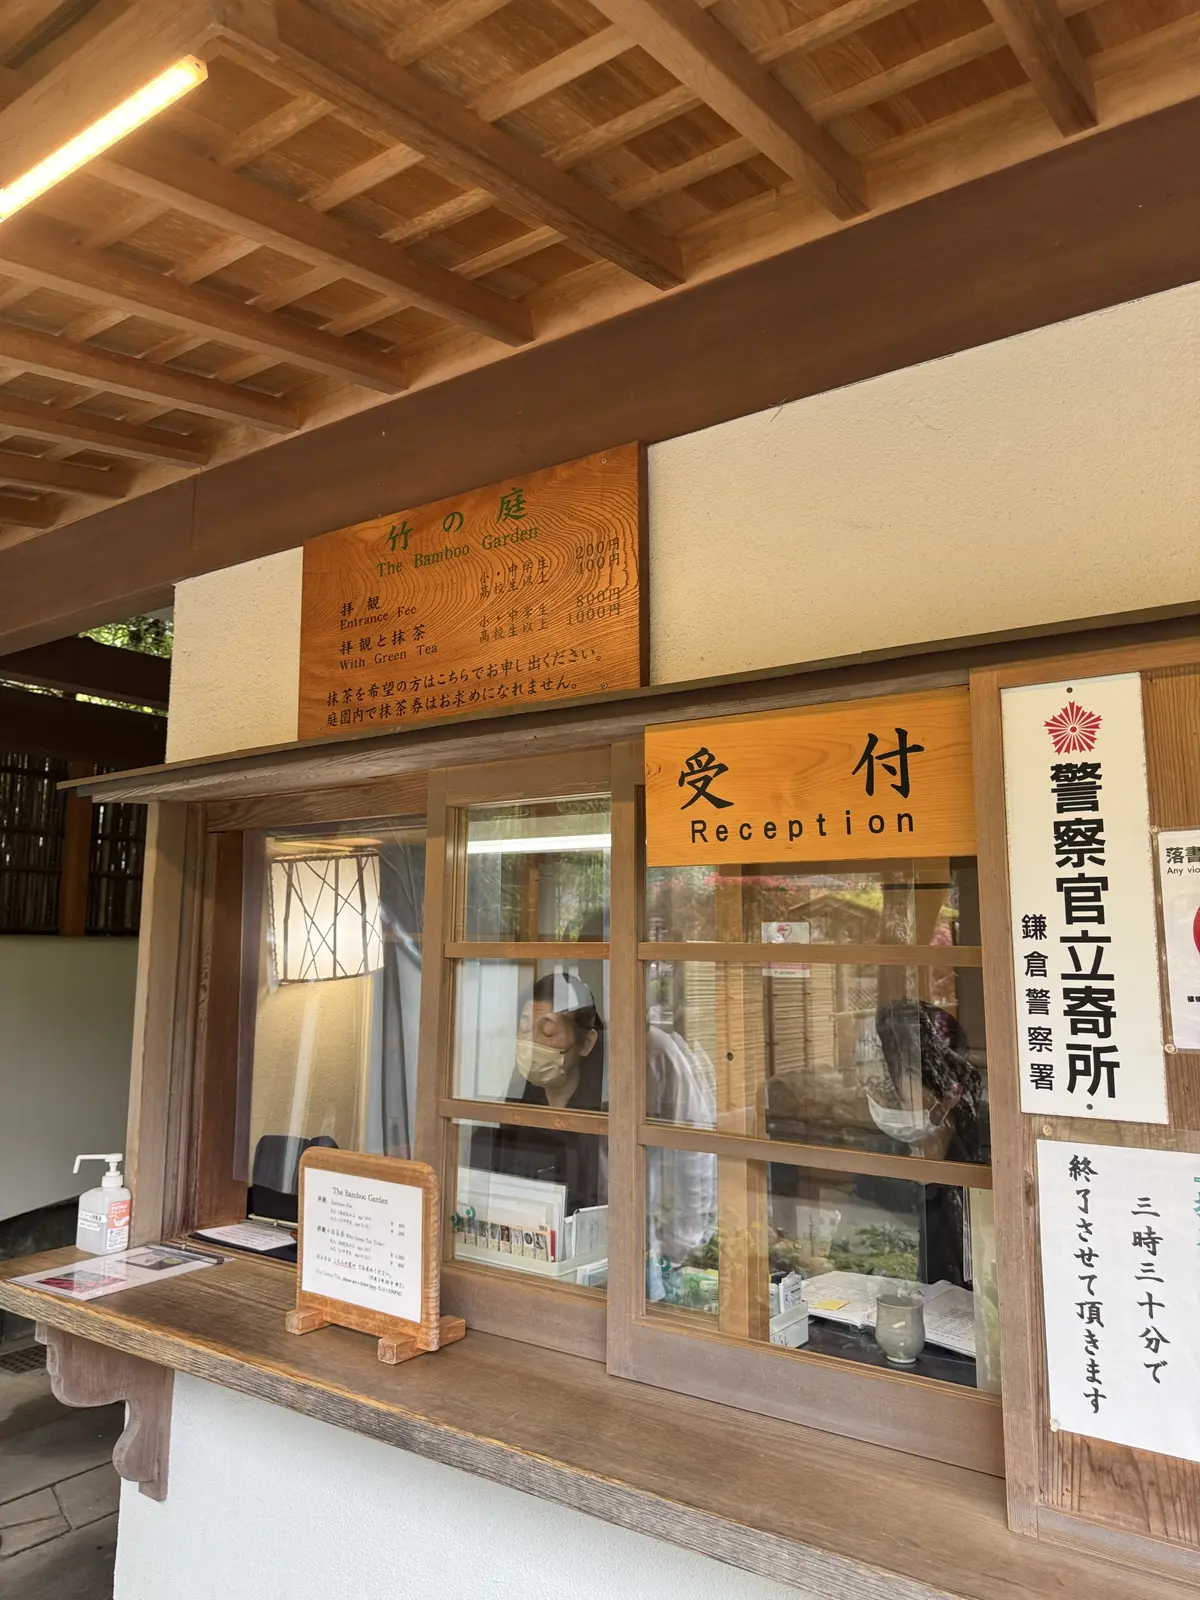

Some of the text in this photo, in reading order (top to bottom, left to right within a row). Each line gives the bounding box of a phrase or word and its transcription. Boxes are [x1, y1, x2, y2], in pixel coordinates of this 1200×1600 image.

[385, 487, 529, 552] 竹の庭
[377, 526, 539, 578] The Bamboo Garden
[576, 537, 620, 560] 200円
[340, 595, 381, 617] 拝観
[576, 587, 620, 608] 800円
[340, 606, 417, 630] Entrance Fee
[567, 602, 620, 626] 1000円
[340, 624, 426, 655] 拝観と抹茶
[340, 645, 438, 670] With Green Tea
[678, 727, 925, 810] 受付
[691, 810, 914, 843] Reception
[1167, 867, 1183, 877] Any
[1050, 761, 1121, 1099] 警察官立寄所
[1021, 913, 1055, 1091] 鎌倉警察署
[332, 1187, 389, 1205] The Bamboo Garden
[1068, 1154, 1107, 1414] 終了させて頂きます
[1131, 1196, 1171, 1384] 三時三十分で
